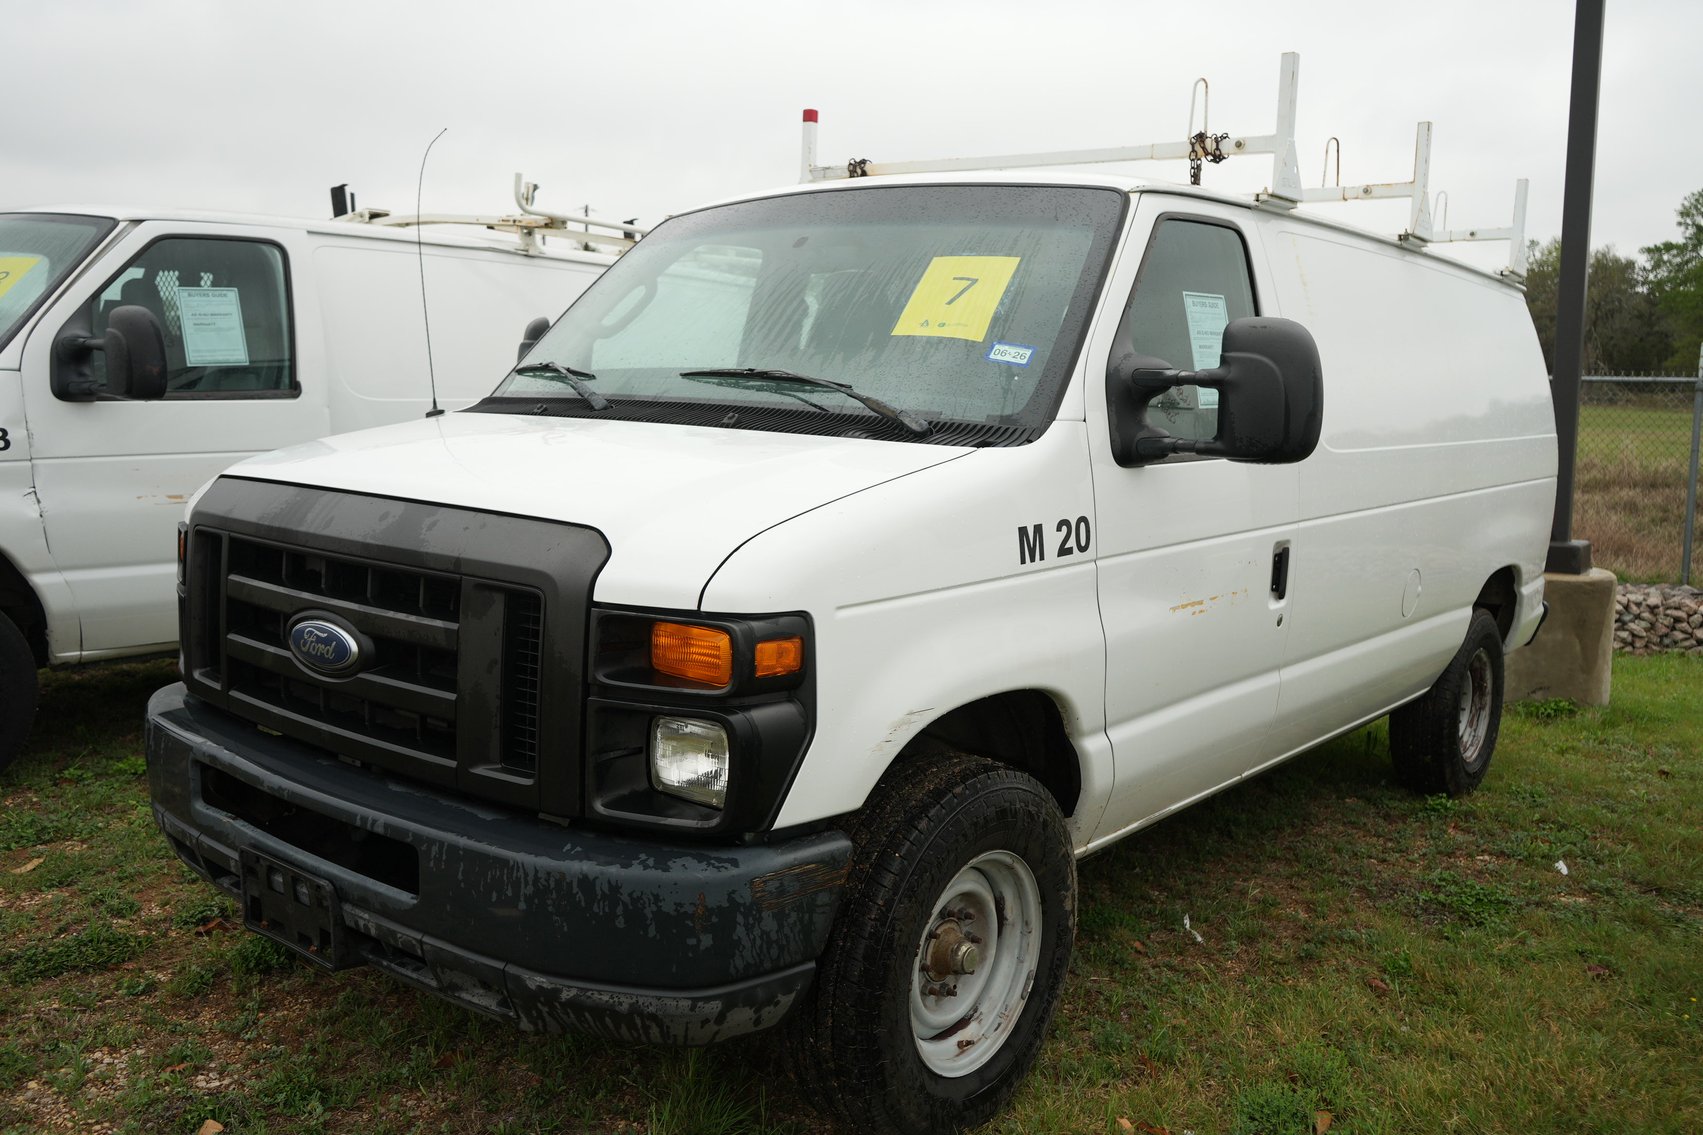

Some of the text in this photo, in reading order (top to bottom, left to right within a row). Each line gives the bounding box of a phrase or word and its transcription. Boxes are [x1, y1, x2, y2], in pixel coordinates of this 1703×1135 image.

[945, 276, 979, 306] 7
[1017, 515, 1091, 565] M 20
[300, 627, 337, 660] Ford
